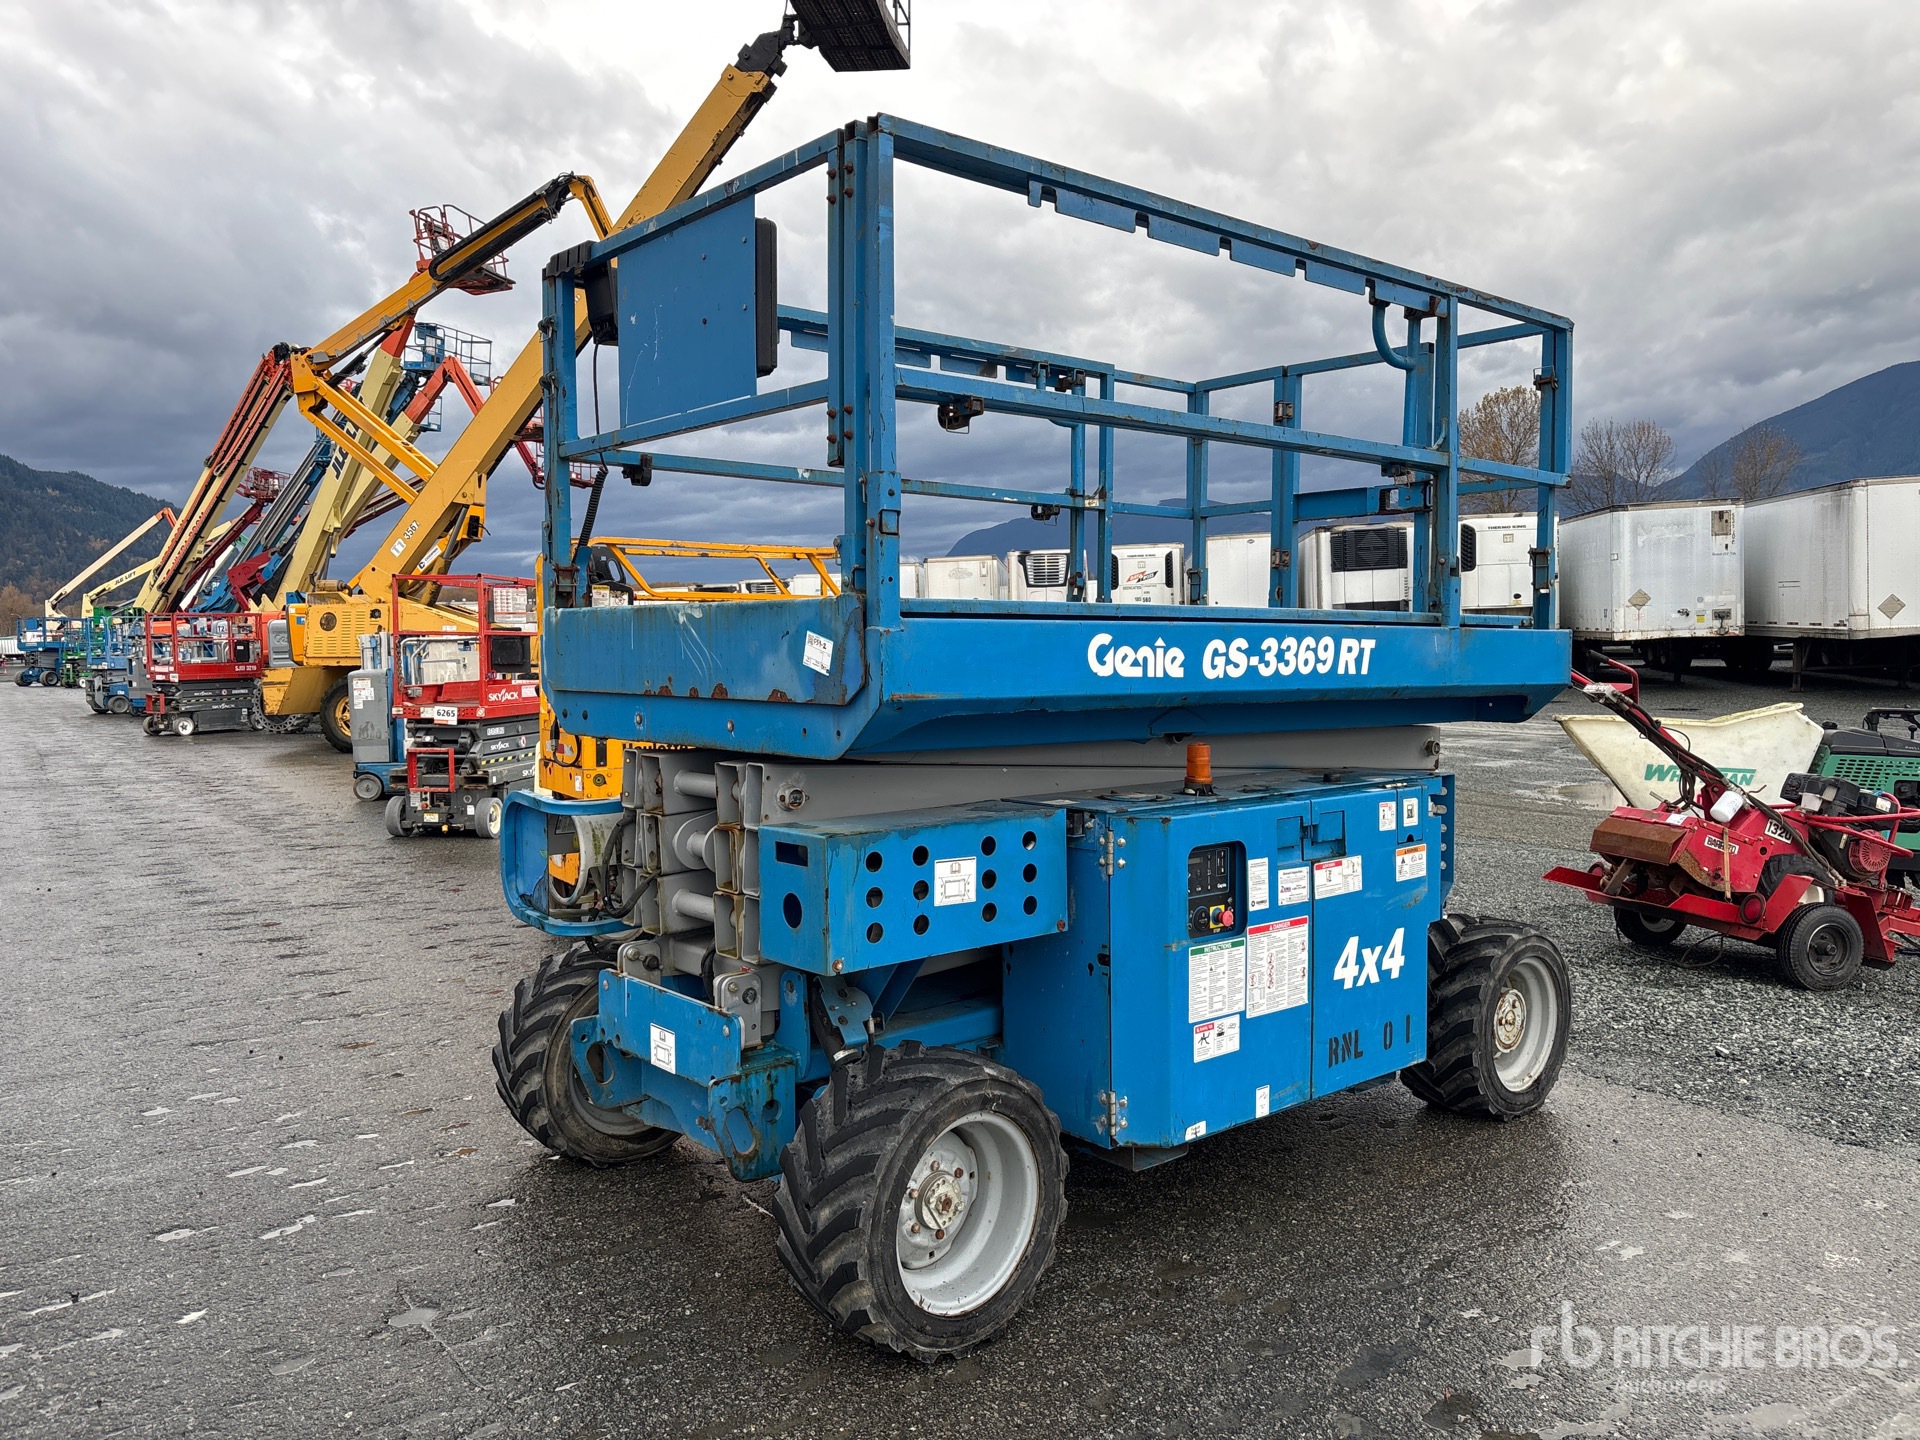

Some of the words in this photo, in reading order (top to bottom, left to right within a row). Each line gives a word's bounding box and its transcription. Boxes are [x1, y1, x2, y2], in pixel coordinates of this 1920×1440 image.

[403, 520, 420, 540] 3567
[1087, 632, 1185, 679] Genie
[488, 688, 519, 702] SKYJACK
[436, 709, 456, 718] 6265
[490, 741, 510, 750] SKYJACK
[1767, 820, 1793, 844] 1320
[1706, 836, 1738, 854] BARRTO
[1273, 921, 1290, 930] DANGER
[1204, 942, 1232, 952] INSTRUCTIONS
[1333, 927, 1405, 990] 4x4
[1328, 1029, 1364, 1068] RNL
